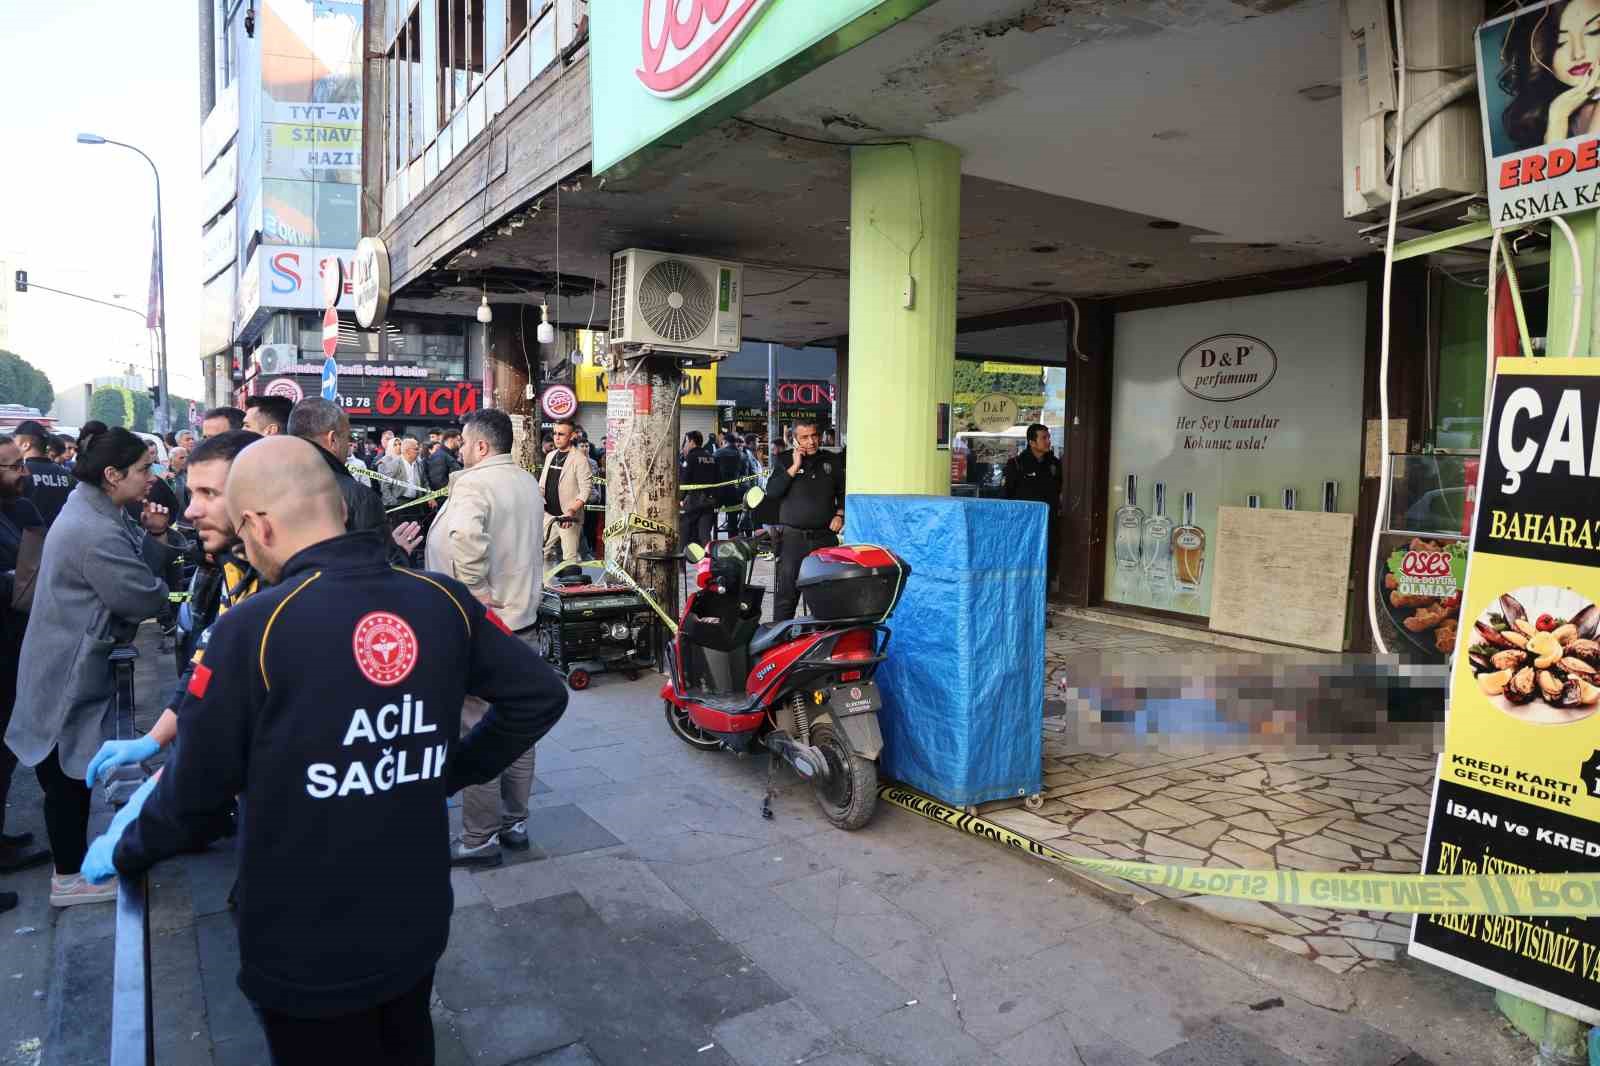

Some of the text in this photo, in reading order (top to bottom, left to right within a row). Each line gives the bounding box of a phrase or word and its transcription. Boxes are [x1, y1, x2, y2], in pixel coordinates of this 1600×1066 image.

[1500, 138, 1600, 190] ERDE
[1194, 370, 1258, 389] perfumum
[1176, 414, 1280, 432] Her Şey Unutulur
[32, 473, 69, 488] POLİS
[1399, 584, 1457, 597] OLMAZ
[342, 693, 438, 746] ACİL
[1451, 753, 1509, 776] KREDİ
[1515, 766, 1578, 795] KARTI
[1454, 767, 1572, 807] GEÇERLİDİR
[1446, 799, 1498, 829] İBAN
[1504, 818, 1529, 837] ve
[1437, 841, 1461, 875] EV
